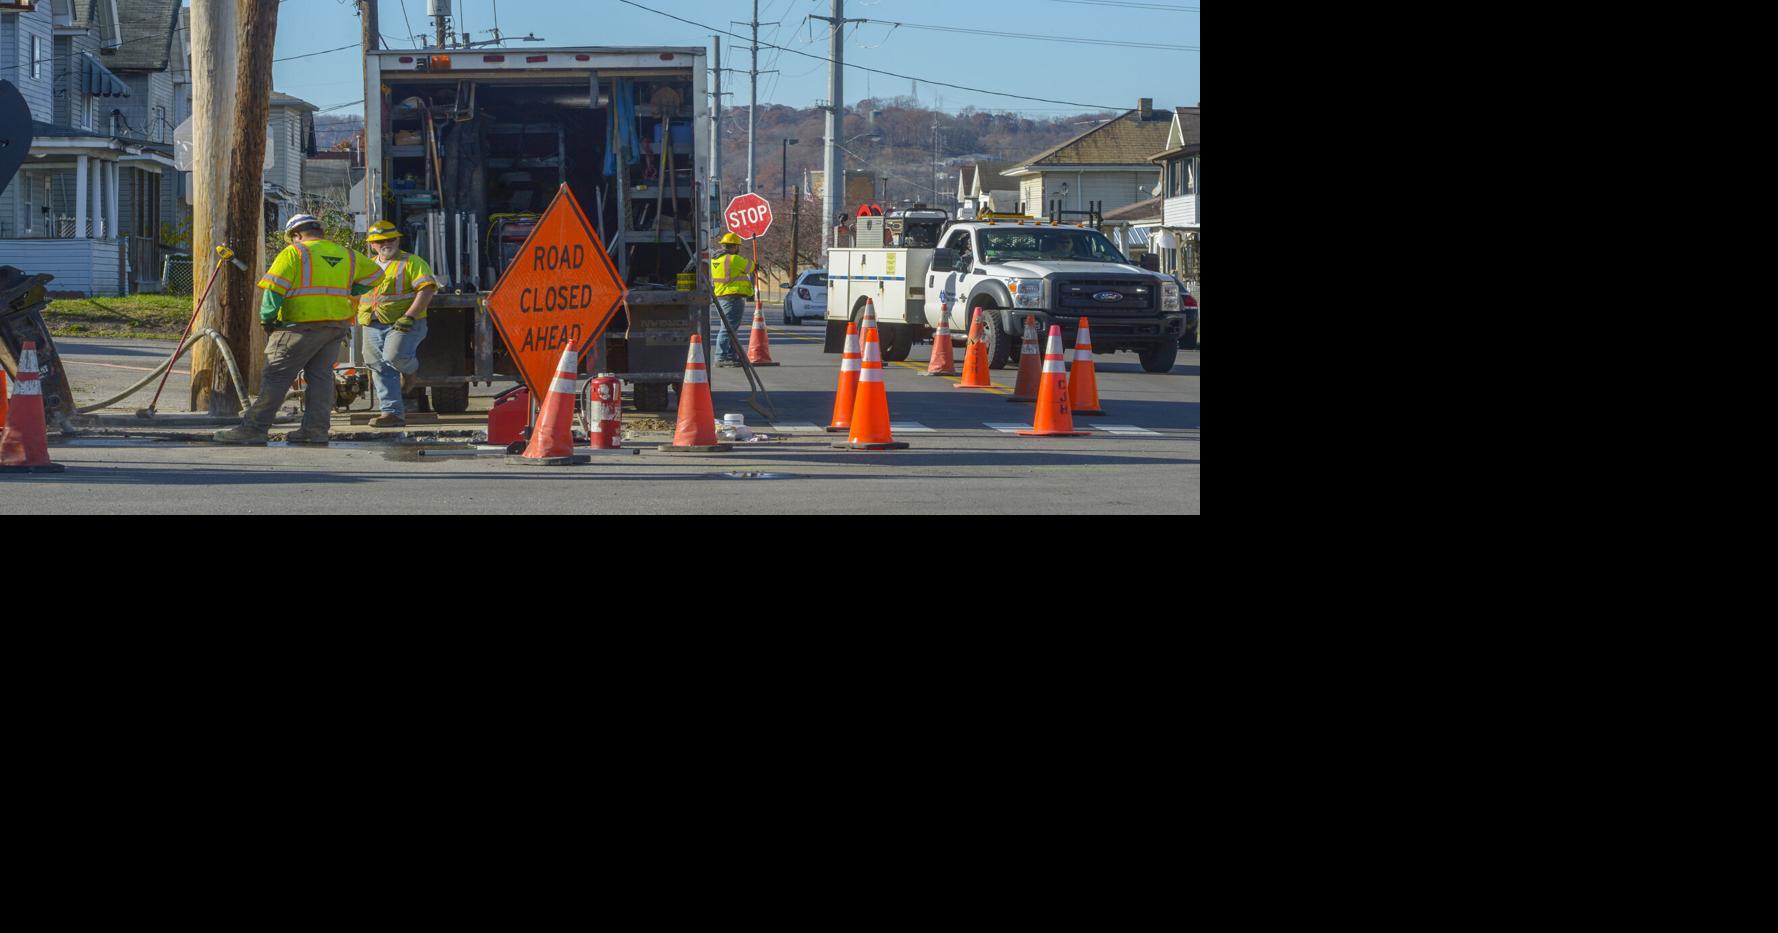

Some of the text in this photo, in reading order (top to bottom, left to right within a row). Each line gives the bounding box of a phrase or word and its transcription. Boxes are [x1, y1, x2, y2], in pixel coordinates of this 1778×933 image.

[729, 205, 768, 228] STOP
[534, 244, 584, 271] ROAD
[520, 284, 593, 313] CLOSED
[520, 323, 582, 353] AHEAD
